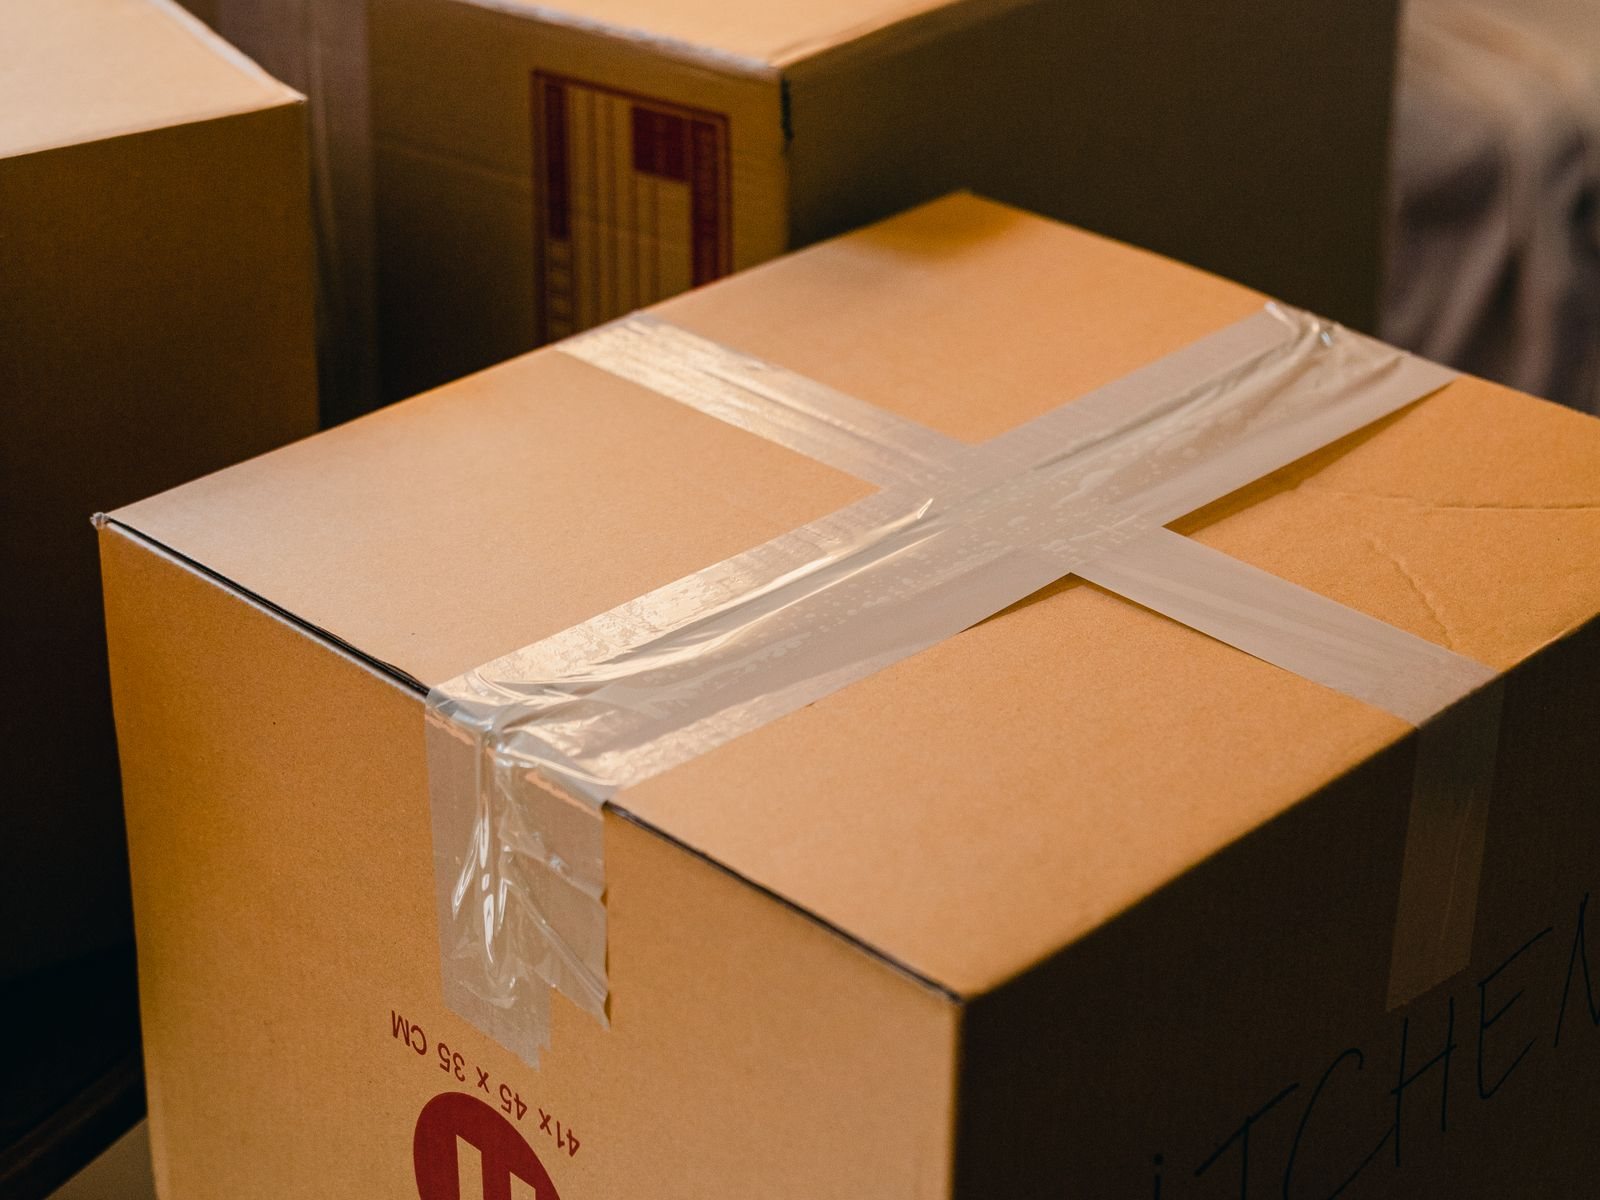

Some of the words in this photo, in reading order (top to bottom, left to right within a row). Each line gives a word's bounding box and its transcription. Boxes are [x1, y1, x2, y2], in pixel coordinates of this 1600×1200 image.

[391, 1010, 427, 1055] CM
[1153, 892, 1600, 1200] TCHEN
[438, 1043, 465, 1082] 35
[476, 1066, 490, 1093] x
[499, 1084, 527, 1120] 45
